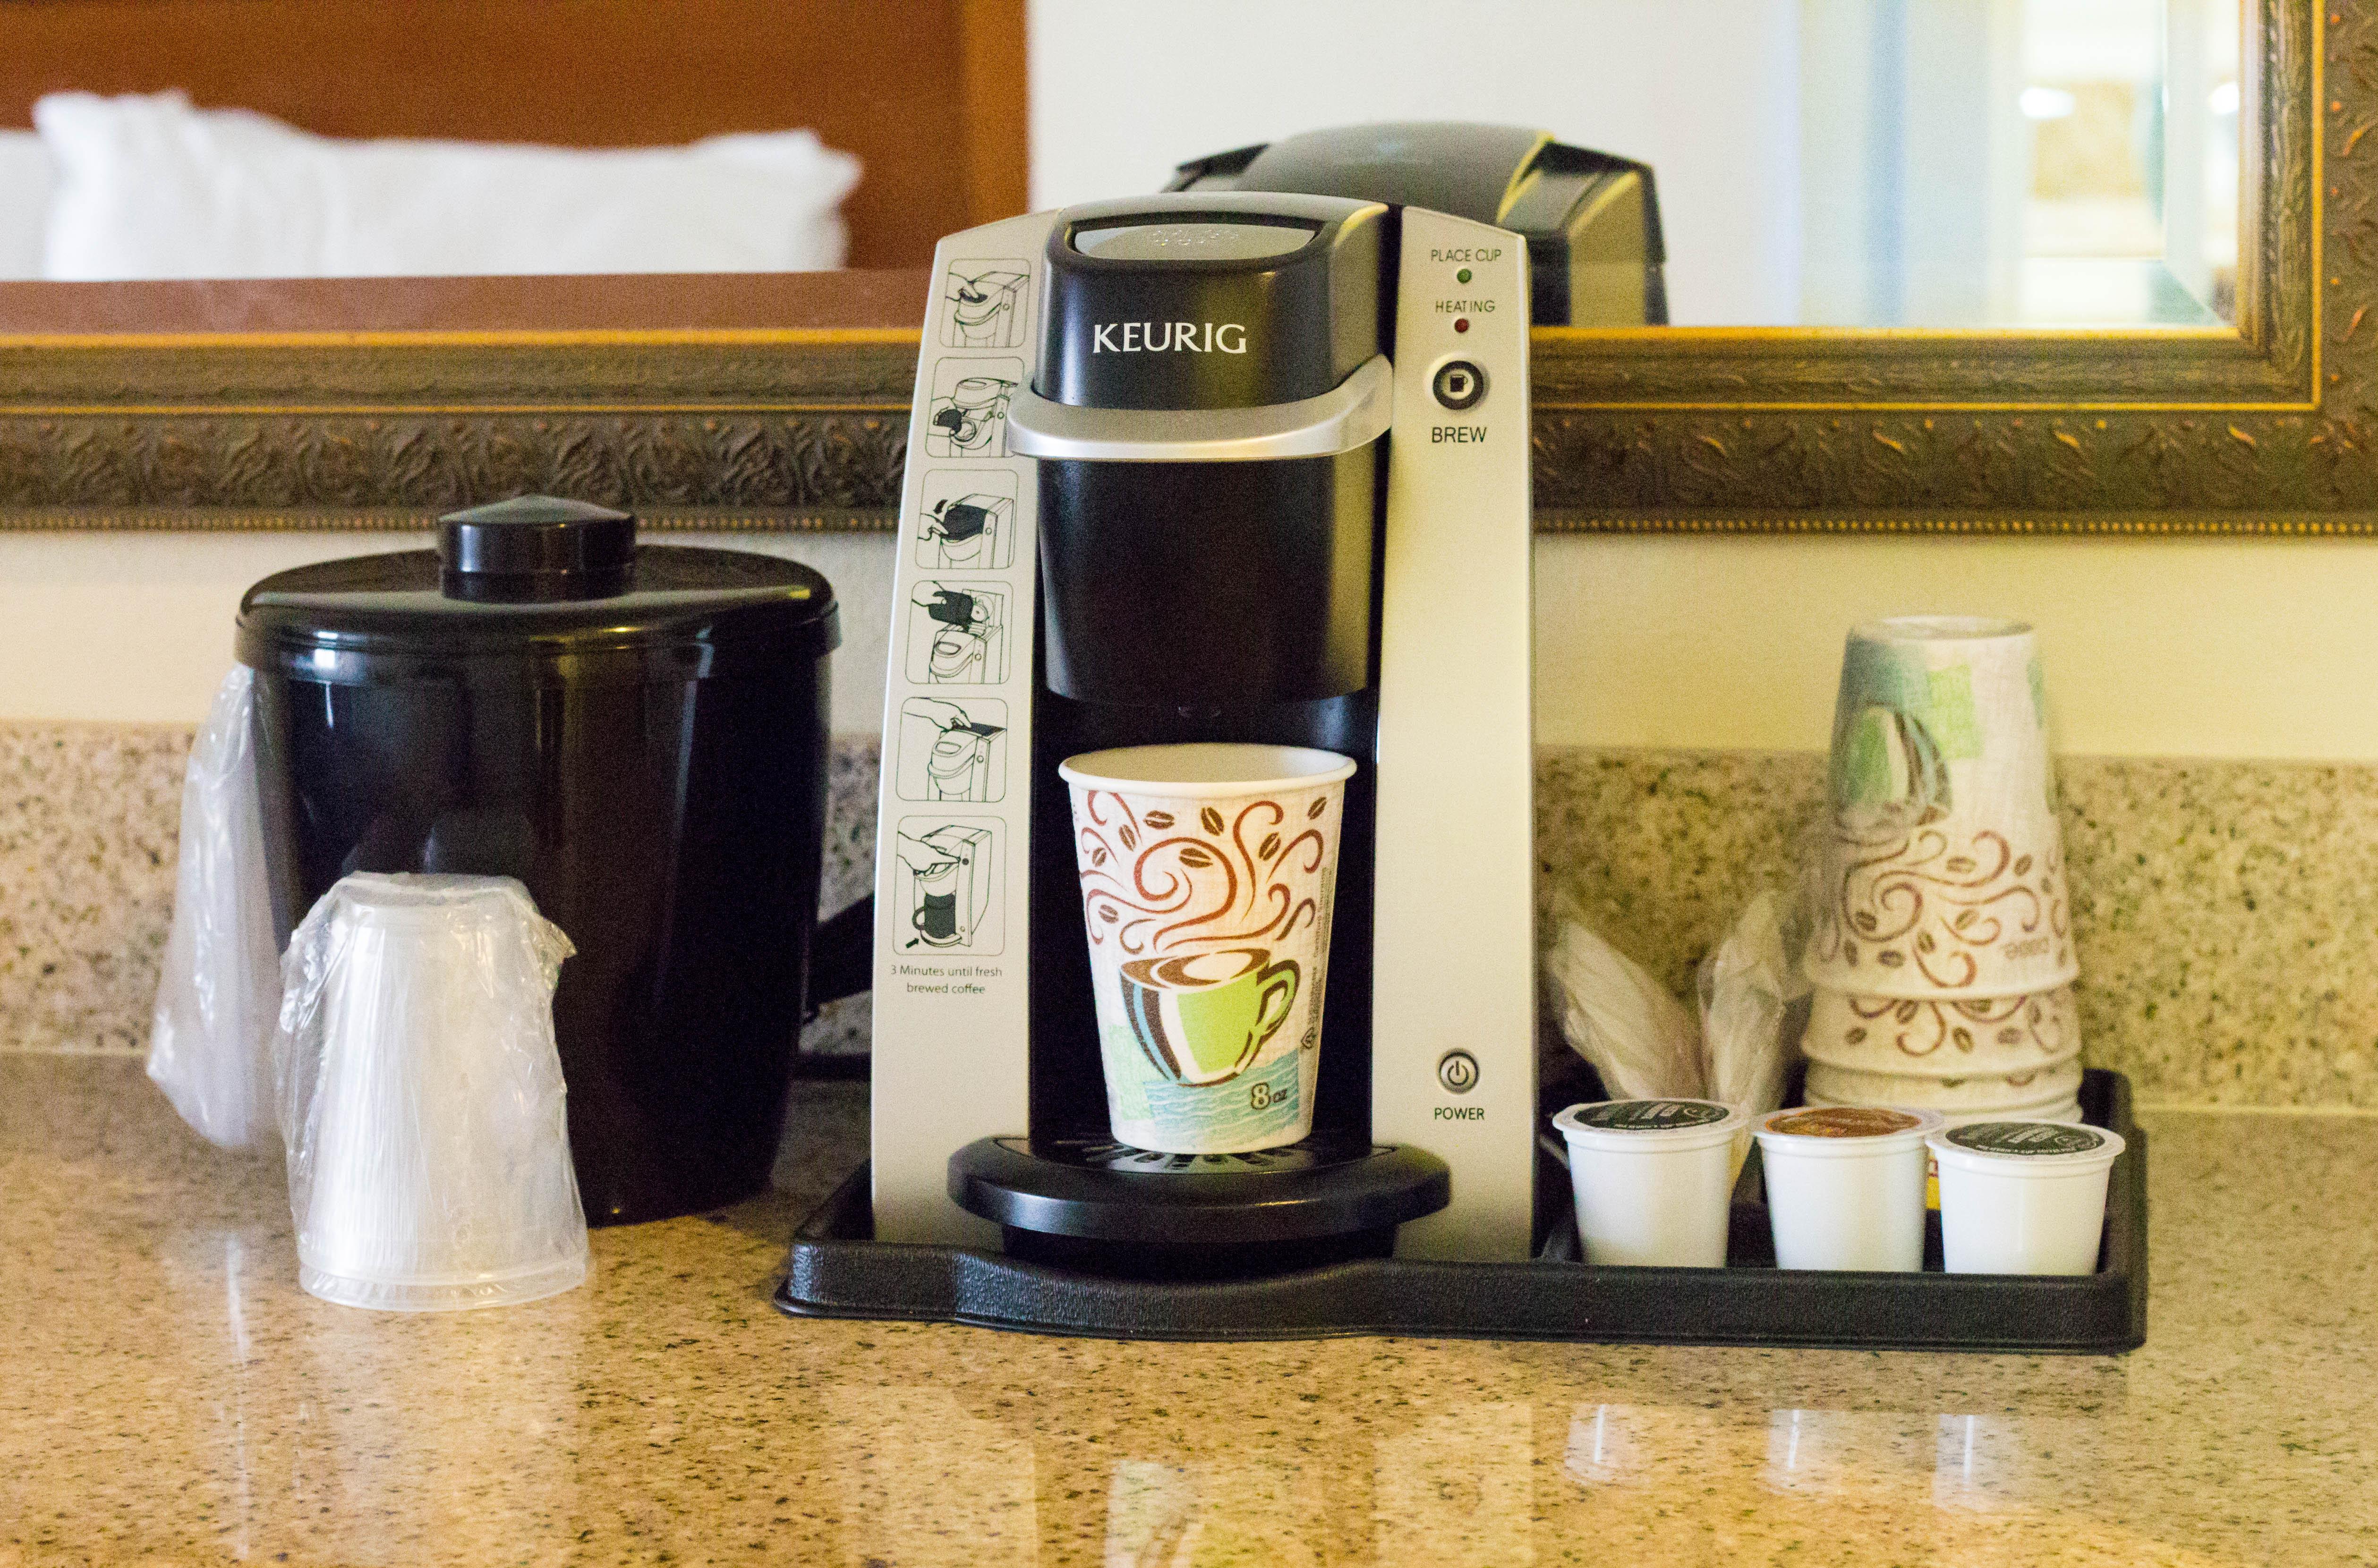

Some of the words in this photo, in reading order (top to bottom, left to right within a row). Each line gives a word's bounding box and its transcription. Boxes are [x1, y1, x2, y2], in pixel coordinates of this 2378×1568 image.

[1431, 248, 1472, 262] PLACE
[1475, 248, 1502, 262] CUP
[1435, 300, 1496, 313] HEATING
[1093, 322, 1246, 354] KEURIG
[1432, 426, 1488, 443] BREW
[891, 965, 896, 975] 3
[900, 965, 945, 976] Minutes
[947, 966, 972, 976] until
[975, 966, 1003, 976] fresh
[906, 982, 948, 993] brewed
[951, 983, 986, 994] coffee
[1434, 1107, 1485, 1120] POWER
